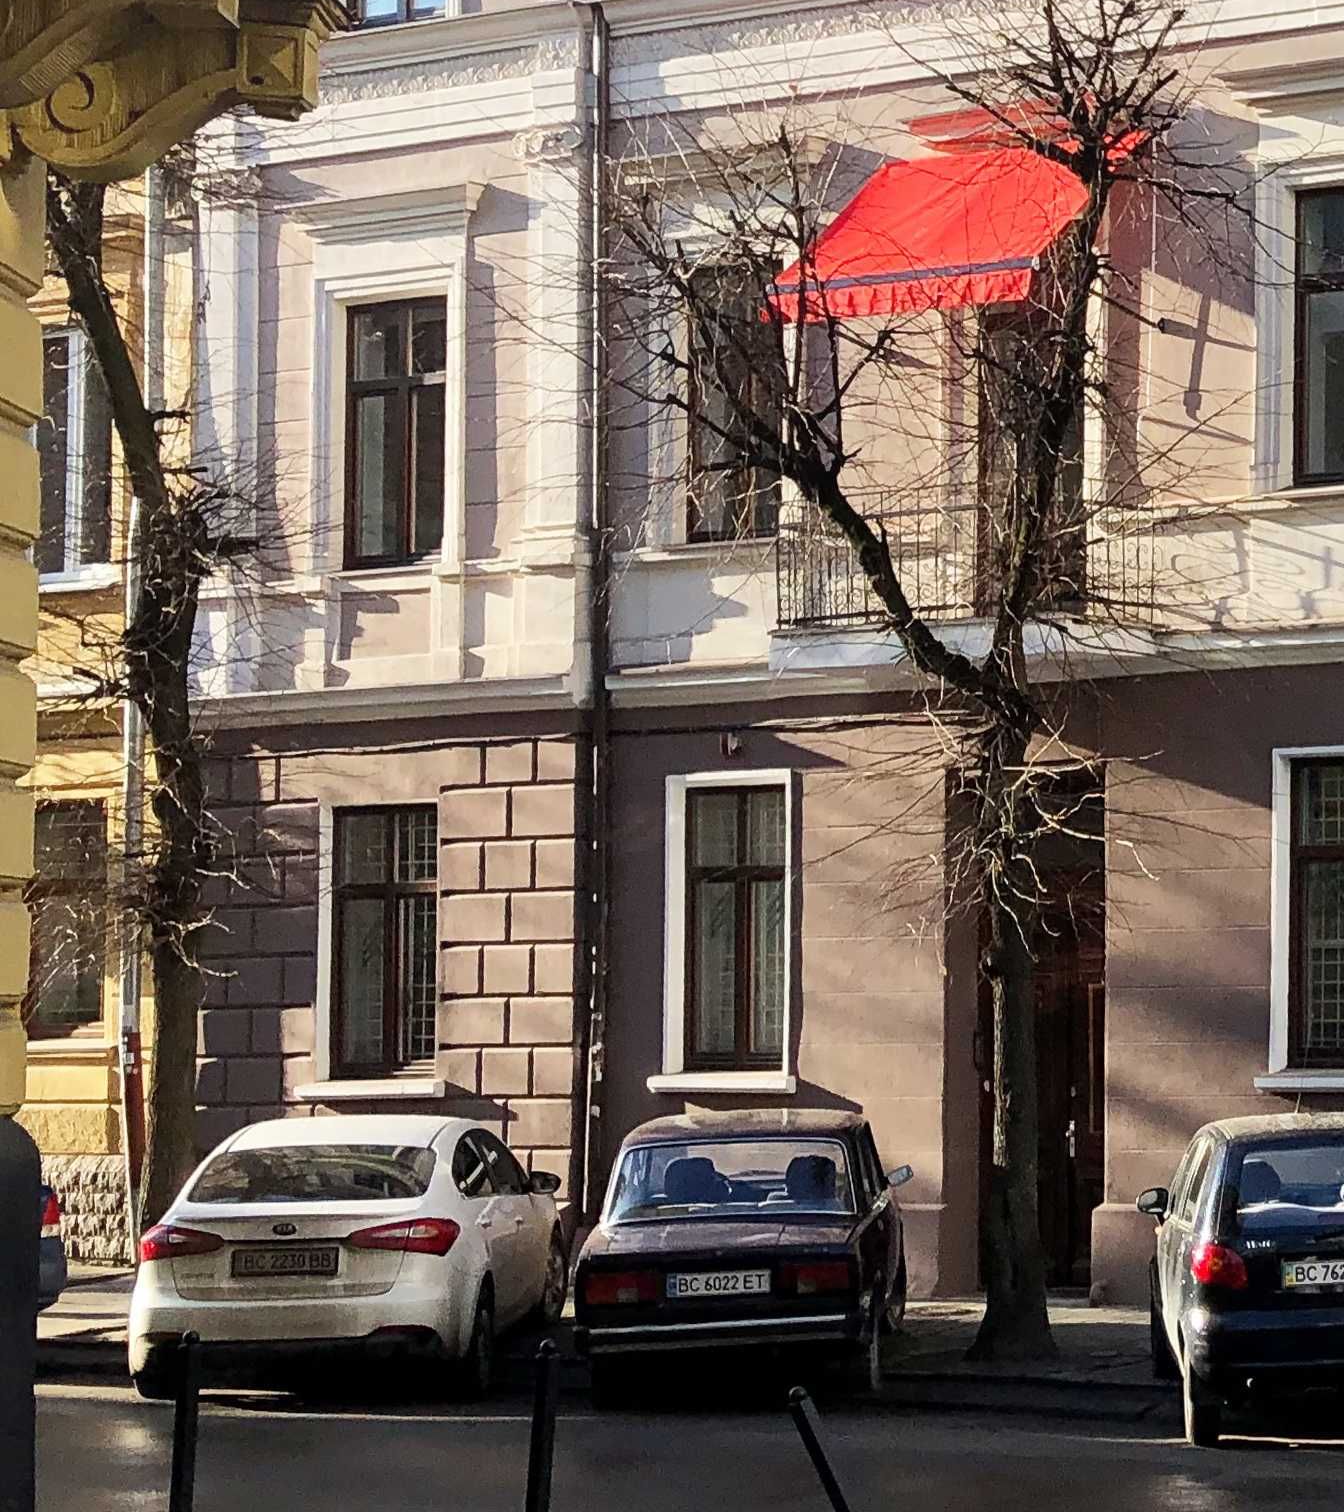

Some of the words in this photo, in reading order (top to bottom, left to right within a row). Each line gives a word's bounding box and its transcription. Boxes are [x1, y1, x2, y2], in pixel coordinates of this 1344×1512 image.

[678, 1277, 701, 1294] BC
[703, 1274, 740, 1292] 6022
[743, 1273, 766, 1290] ET
[1295, 1265, 1318, 1283] BC
